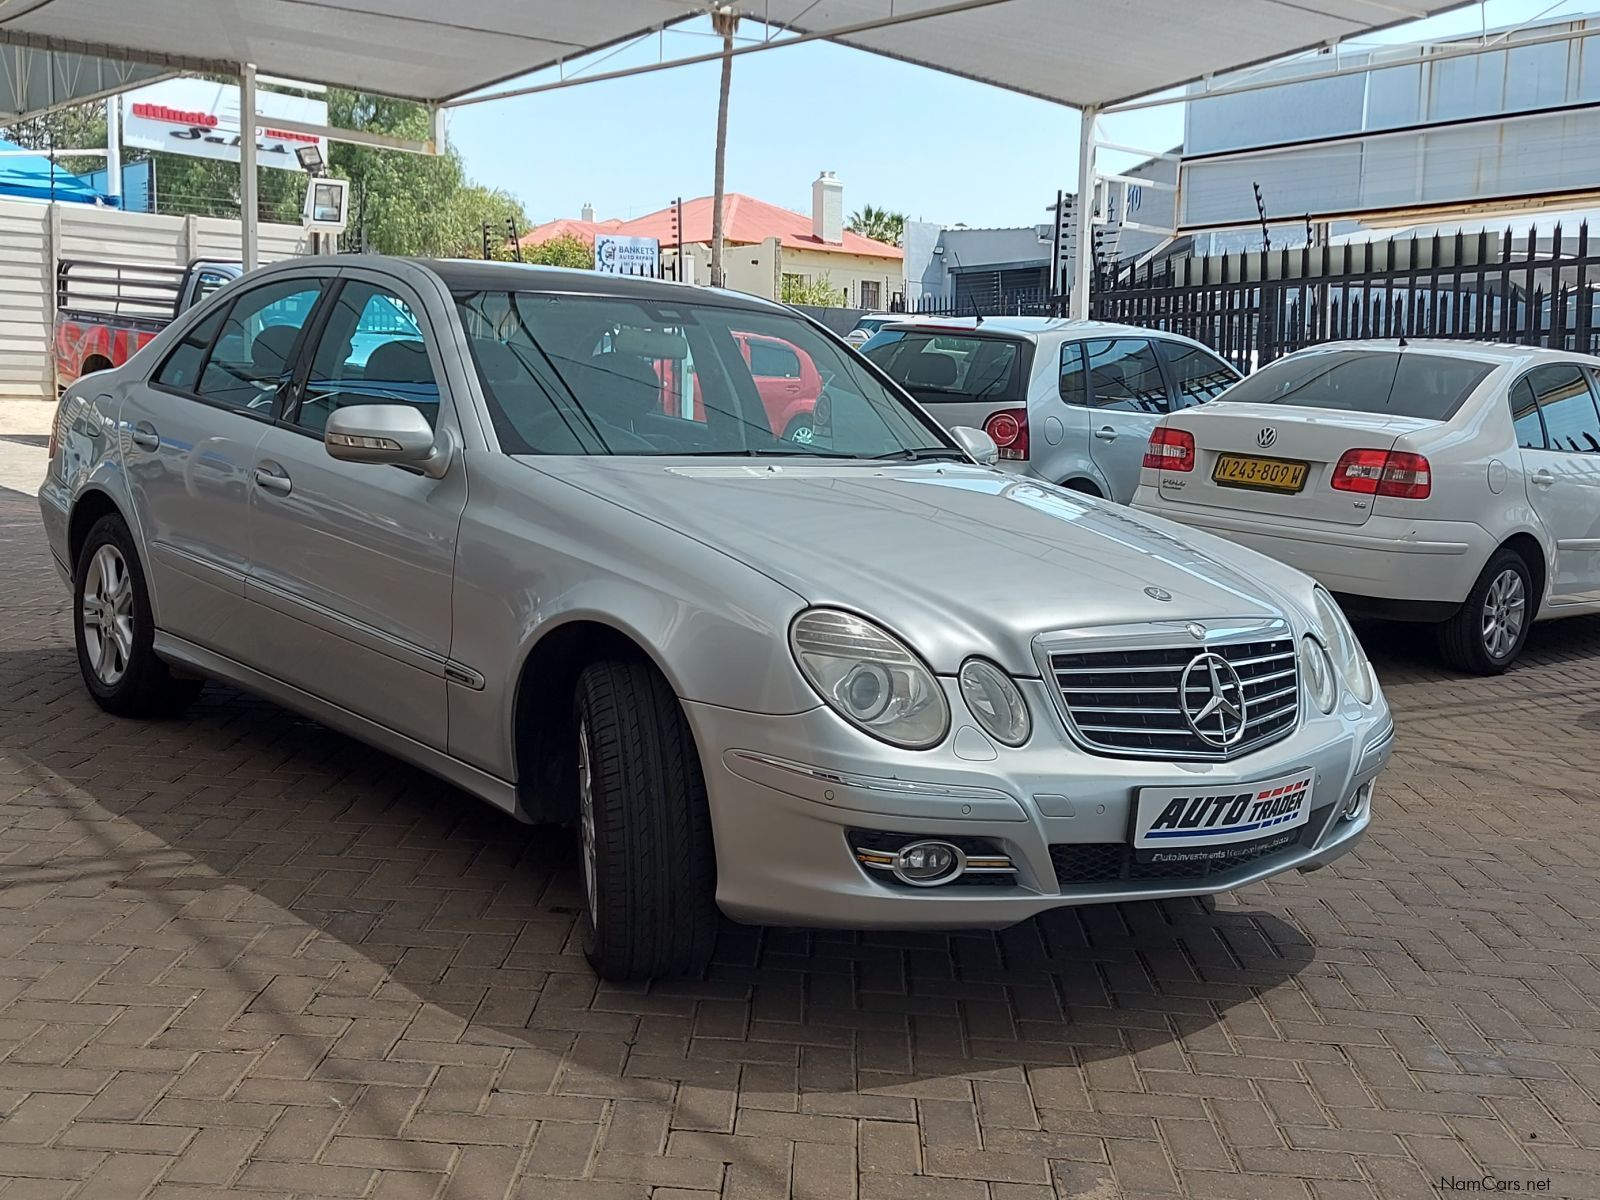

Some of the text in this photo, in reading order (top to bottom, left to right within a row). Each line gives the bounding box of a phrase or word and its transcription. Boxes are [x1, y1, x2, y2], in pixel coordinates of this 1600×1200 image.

[618, 245, 655, 255] BANKETS
[1229, 462, 1289, 483] 243-809
[1150, 789, 1307, 830] AUTO TRADER
